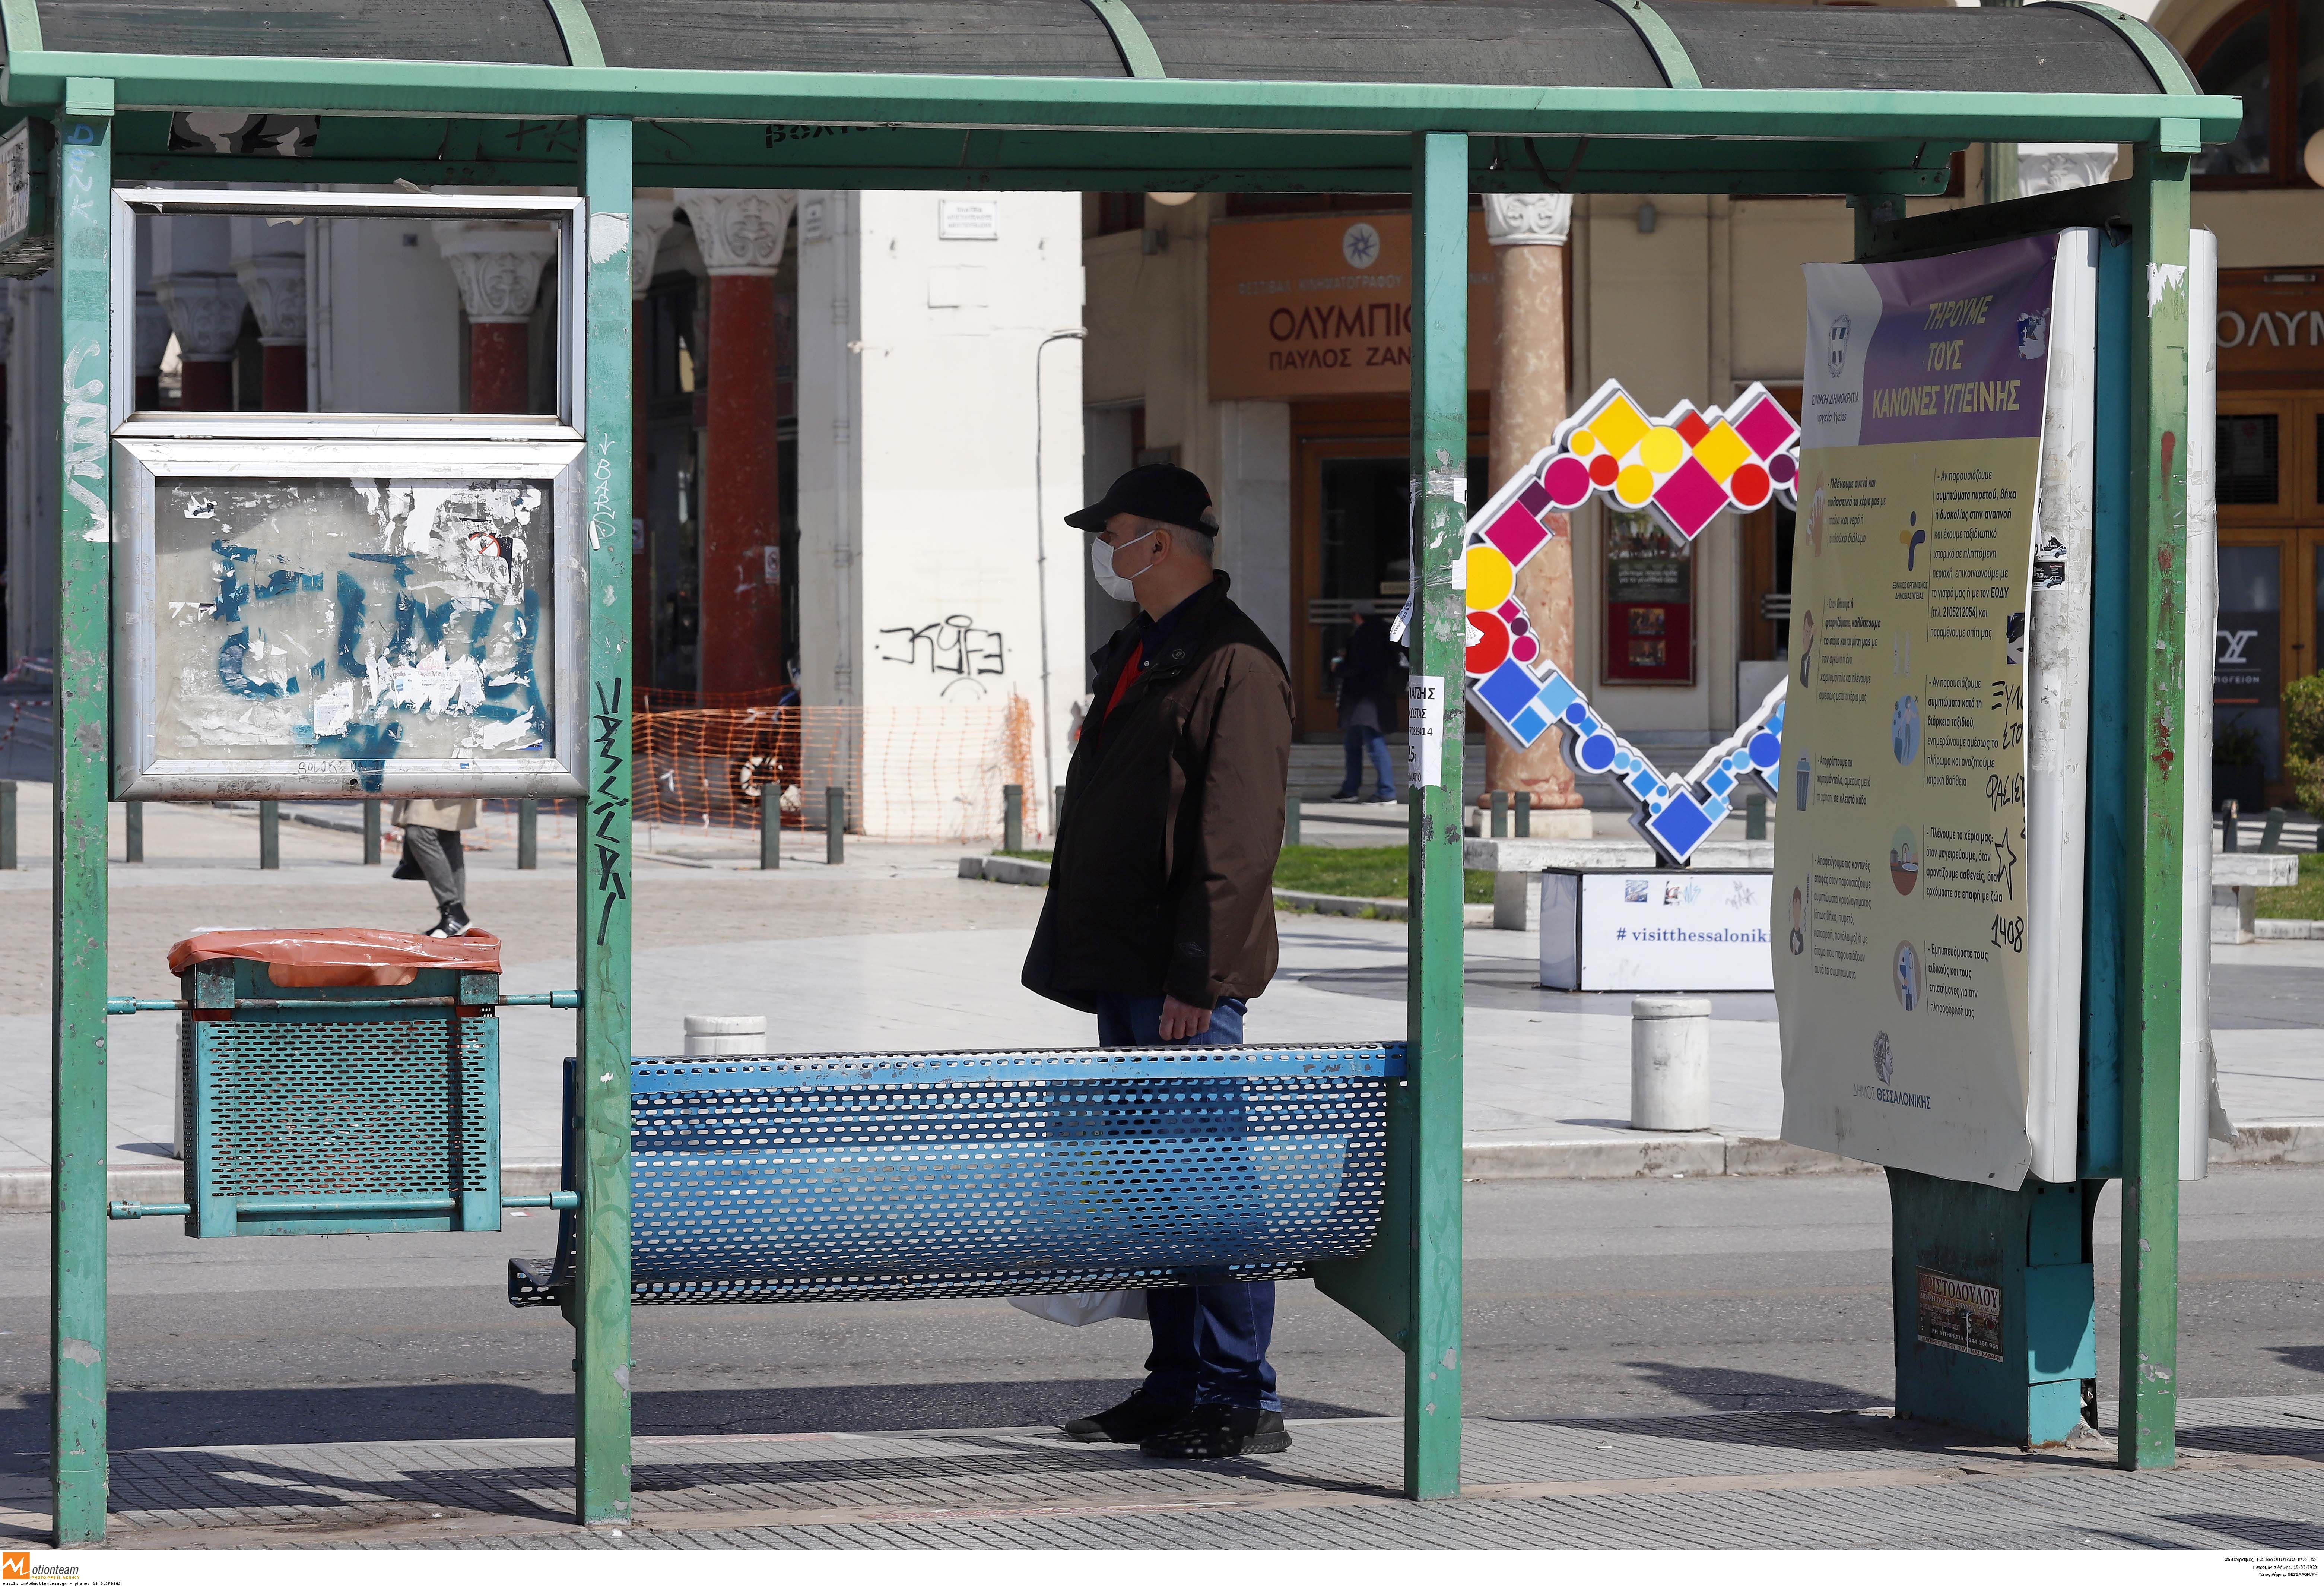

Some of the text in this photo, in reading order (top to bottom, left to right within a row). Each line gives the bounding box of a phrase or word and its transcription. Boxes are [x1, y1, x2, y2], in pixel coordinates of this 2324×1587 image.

[1923, 295, 1993, 330] ΤΗΡΟΥΜΕ
[1270, 347, 1352, 370] ΠΑΥΛΟΣ
[1927, 339, 1964, 371] ΤΟΥΣ
[1829, 392, 1859, 404] ΔΗΜΟΚΡΑΤΙΑ
[1873, 380, 2021, 419] ΚΑΝΟΝΕΣ ΥΓΙΕΙΝΗΣ
[1834, 411, 1847, 424] Υγείας
[1830, 478, 1854, 491] Πλένουμε
[1855, 476, 1867, 488] συχνά
[1941, 469, 1992, 484] Αν παρουσιάζουμε
[1859, 495, 1871, 508] χέρια
[1936, 488, 2017, 503] συμπτώματα πυρετού, βήχα
[1850, 514, 1860, 527] νερό
[1940, 507, 2012, 522] δυσκολίας στην αναπνοή
[1943, 528, 1962, 541] έχουμε
[1964, 528, 1997, 541] ταξιδιωτικό
[1934, 548, 1962, 561] ιστορικό σε
[1933, 567, 2008, 581] περιοχή, επικοινωνούμε με
[1931, 587, 2009, 601] το γιατρό μας με τον ΕΟΔΥ
[1943, 606, 1988, 618] 2105212054) και
[1852, 616, 1881, 630] καλύπτουμε
[1930, 626, 1992, 640] παραμένουμε σπίτι μας
[1862, 638, 1870, 649] μας
[1933, 677, 1981, 691] Αν παρουσιάζουμε
[1928, 697, 1982, 709] συμπτώματα κατά τη
[1927, 715, 1975, 729] διάρκεια ταξιδιού,
[1927, 735, 1998, 750] ενημερώνουμε αμέσως το
[1927, 754, 1995, 771] πλήρωμα και αναζητούμε
[1845, 775, 1870, 789] αμέσως μετά
[1927, 774, 1967, 787] ιατρική βοήθεια
[1839, 793, 1867, 805] κλειστό κάδο
[1931, 827, 1955, 842] Πλένουμε
[1964, 830, 1979, 843] χέρια
[1981, 833, 1993, 844] μας:
[1926, 846, 1991, 862] όταν μαγειρεύουμε, όταν
[1817, 854, 1844, 870] Αποφεύγουμε
[1852, 860, 1870, 873] κοντινές
[1815, 874, 1871, 891] επαφές όταν παρουσιάζουμε
[1926, 867, 2000, 883] φροντίζουμε ασθενείς, όταν
[1839, 895, 1871, 910] κρυολογήματος
[1926, 886, 2003, 904] ερχόμαστε σε επαφή με ζώα
[1839, 913, 1854, 925] πυρετό,
[1991, 914, 2024, 953] 1408
[1835, 950, 1865, 964] παρουσιάζουν
[1931, 943, 1988, 963] Εμπιστευόμαστε τους
[1928, 963, 1949, 978] ειδικούς
[1959, 969, 1972, 980] τους
[1929, 983, 1959, 998] επιστήμονες
[1969, 989, 1978, 998] την
[1930, 1001, 1974, 1020] πληροφόρησή μας
[1853, 1083, 1931, 1110] ΔΗΜΟΣ ΘΕΣΣΑΛΟΝΙΚΗΣ
[1919, 1273, 1998, 1308] ΧΡΙΣΤΟΔΟΥΛΟΥ
[1982, 1352, 2000, 1361] ΚΑΘΑΡΗ
